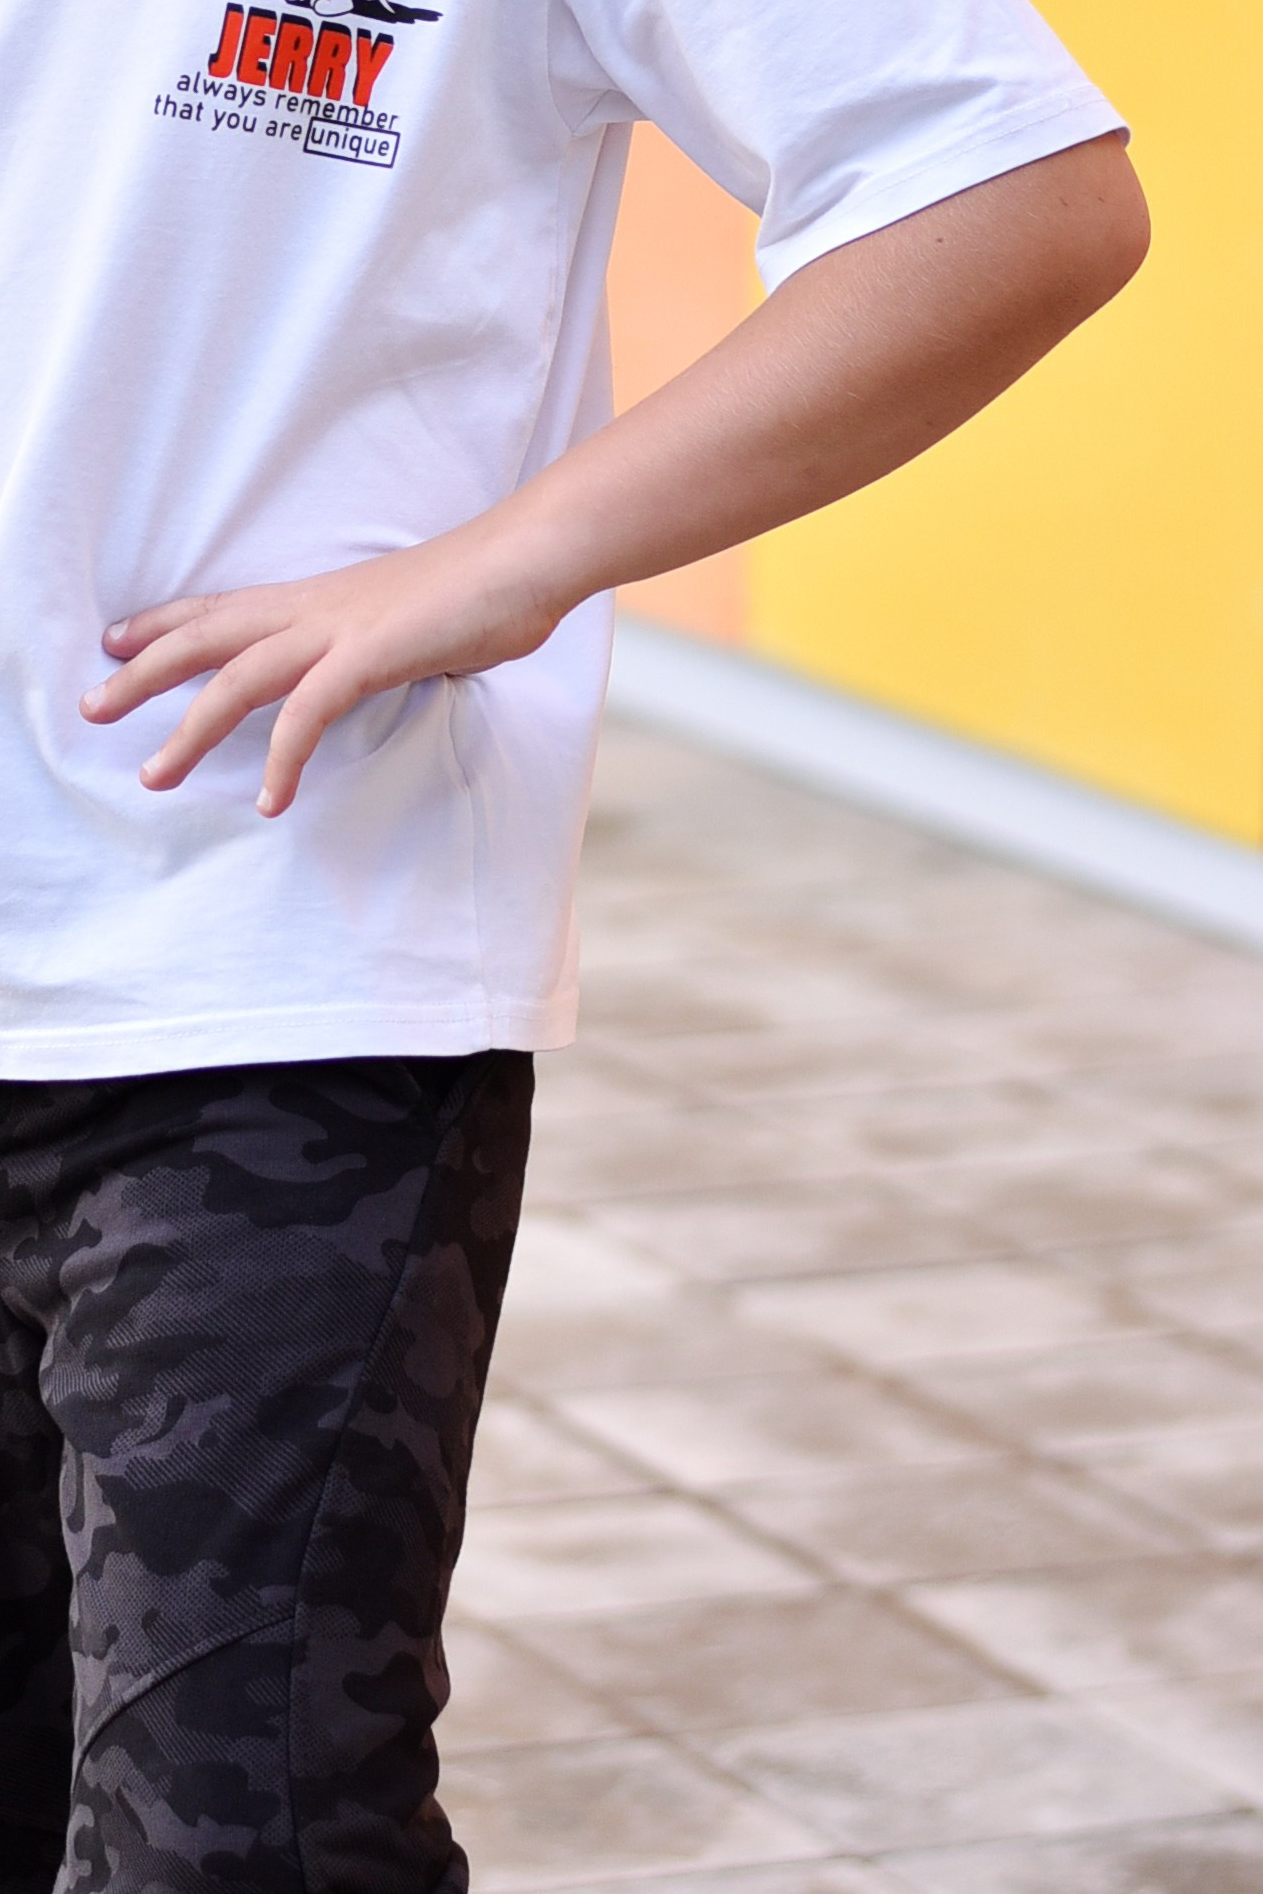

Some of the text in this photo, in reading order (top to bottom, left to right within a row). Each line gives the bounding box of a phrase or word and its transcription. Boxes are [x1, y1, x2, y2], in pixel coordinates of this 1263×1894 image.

[207, 1, 395, 107] JERRY
[153, 94, 390, 158] that you are unique
[176, 71, 399, 130] always remember
